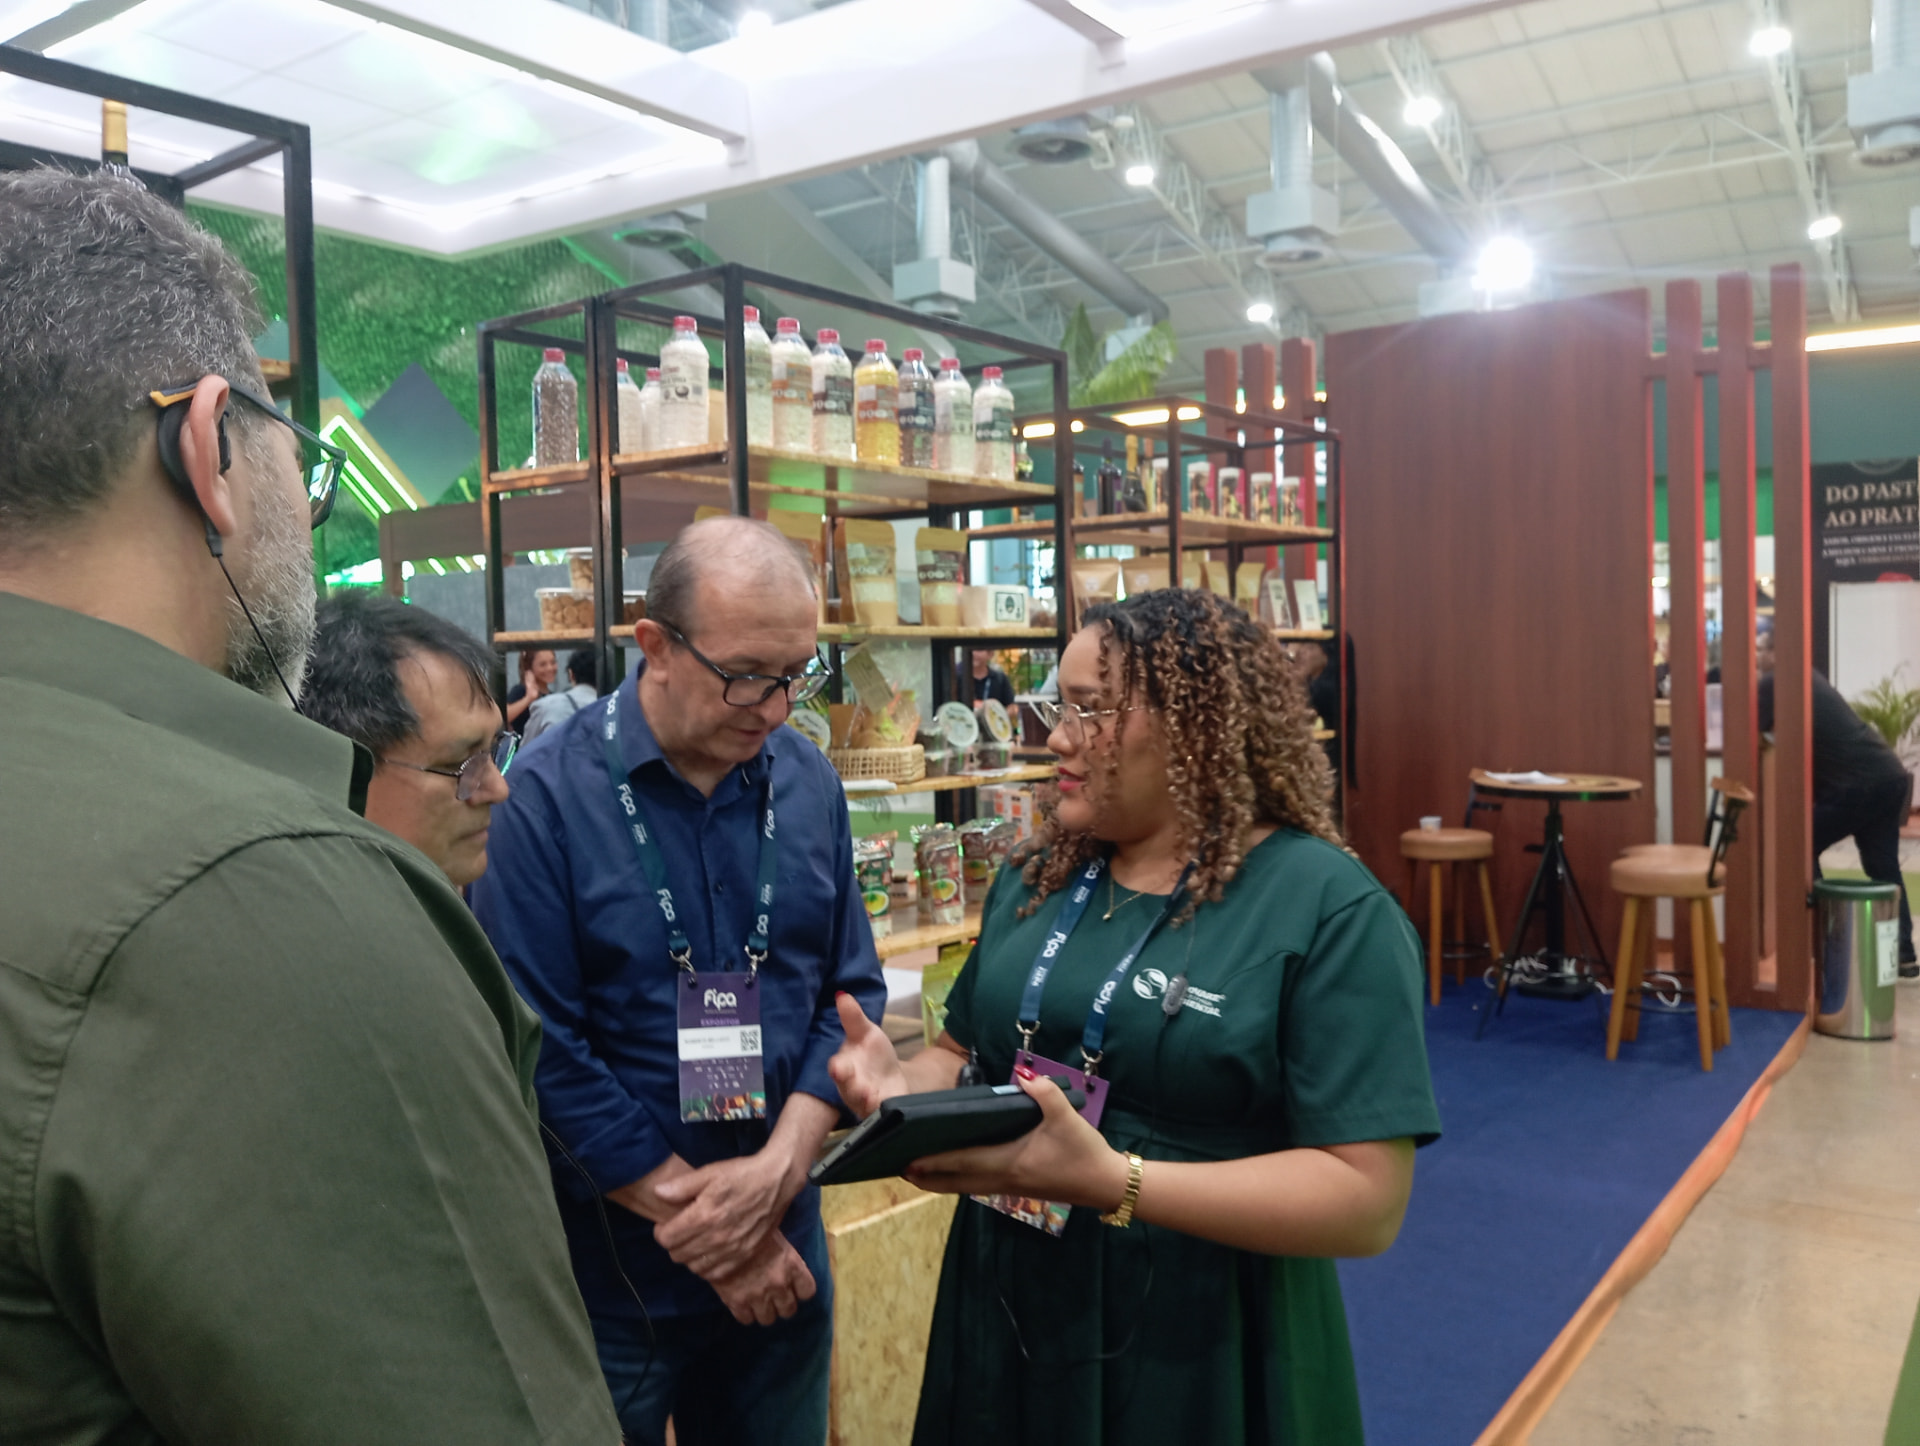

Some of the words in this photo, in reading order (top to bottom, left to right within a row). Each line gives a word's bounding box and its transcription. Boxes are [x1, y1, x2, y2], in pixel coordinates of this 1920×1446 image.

[1825, 484, 1859, 506] DO
[1862, 479, 1919, 501] PAST
[1824, 509, 1857, 529] AO
[1861, 505, 1919, 526] PRAT
